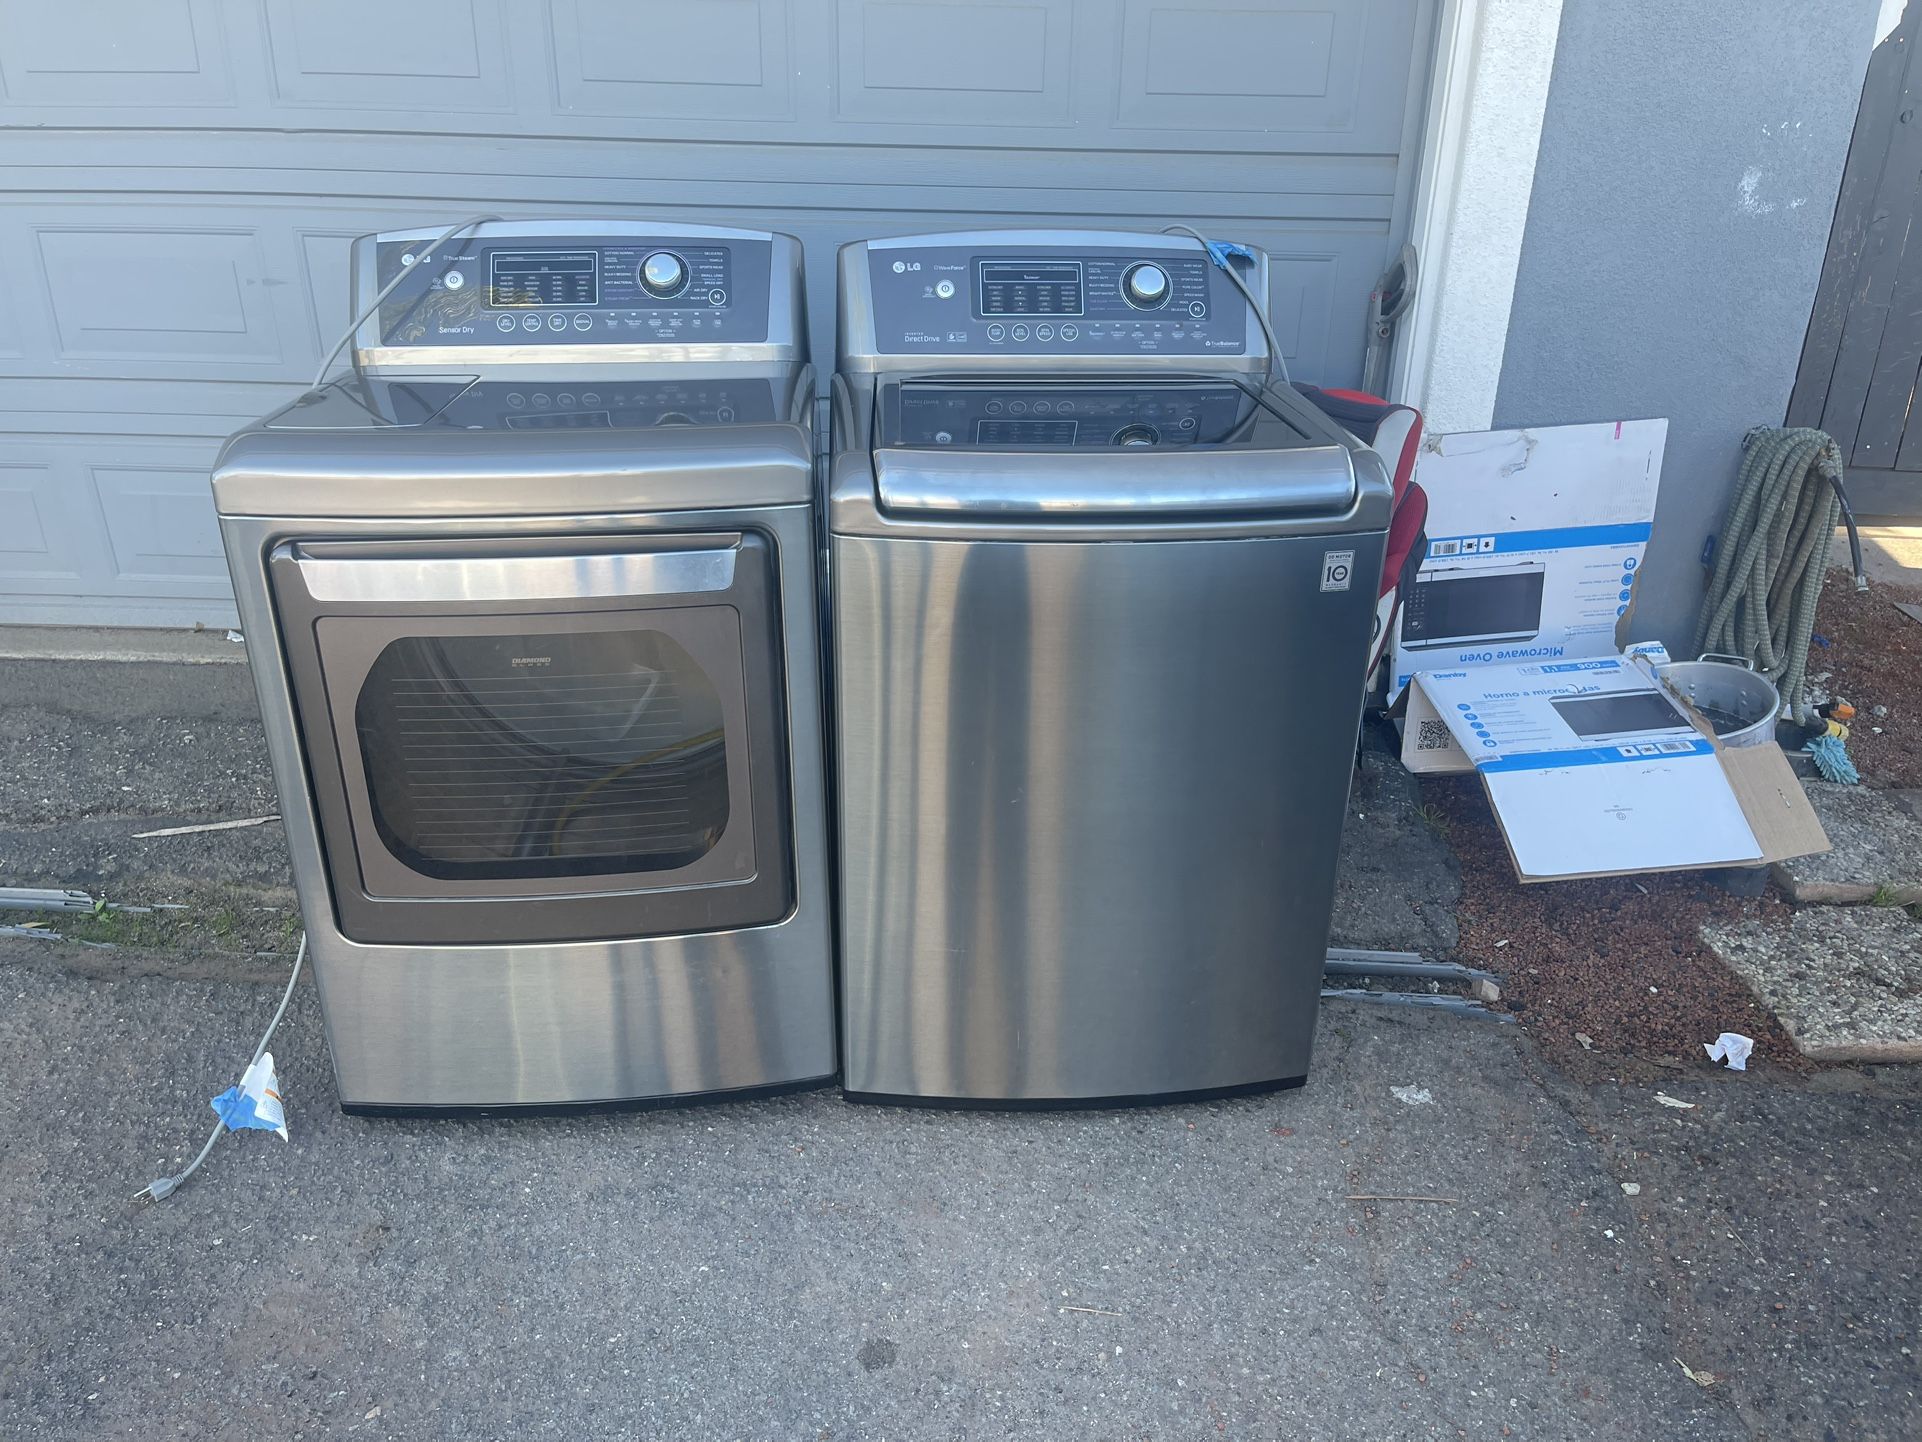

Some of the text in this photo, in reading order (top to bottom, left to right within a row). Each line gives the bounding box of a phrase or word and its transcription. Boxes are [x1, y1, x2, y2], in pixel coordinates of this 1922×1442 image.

[906, 262, 921, 271] LG
[439, 326, 475, 334] Sensor Dry
[1327, 565, 1348, 582] 10
[1460, 646, 1563, 662] Microwave Oven
